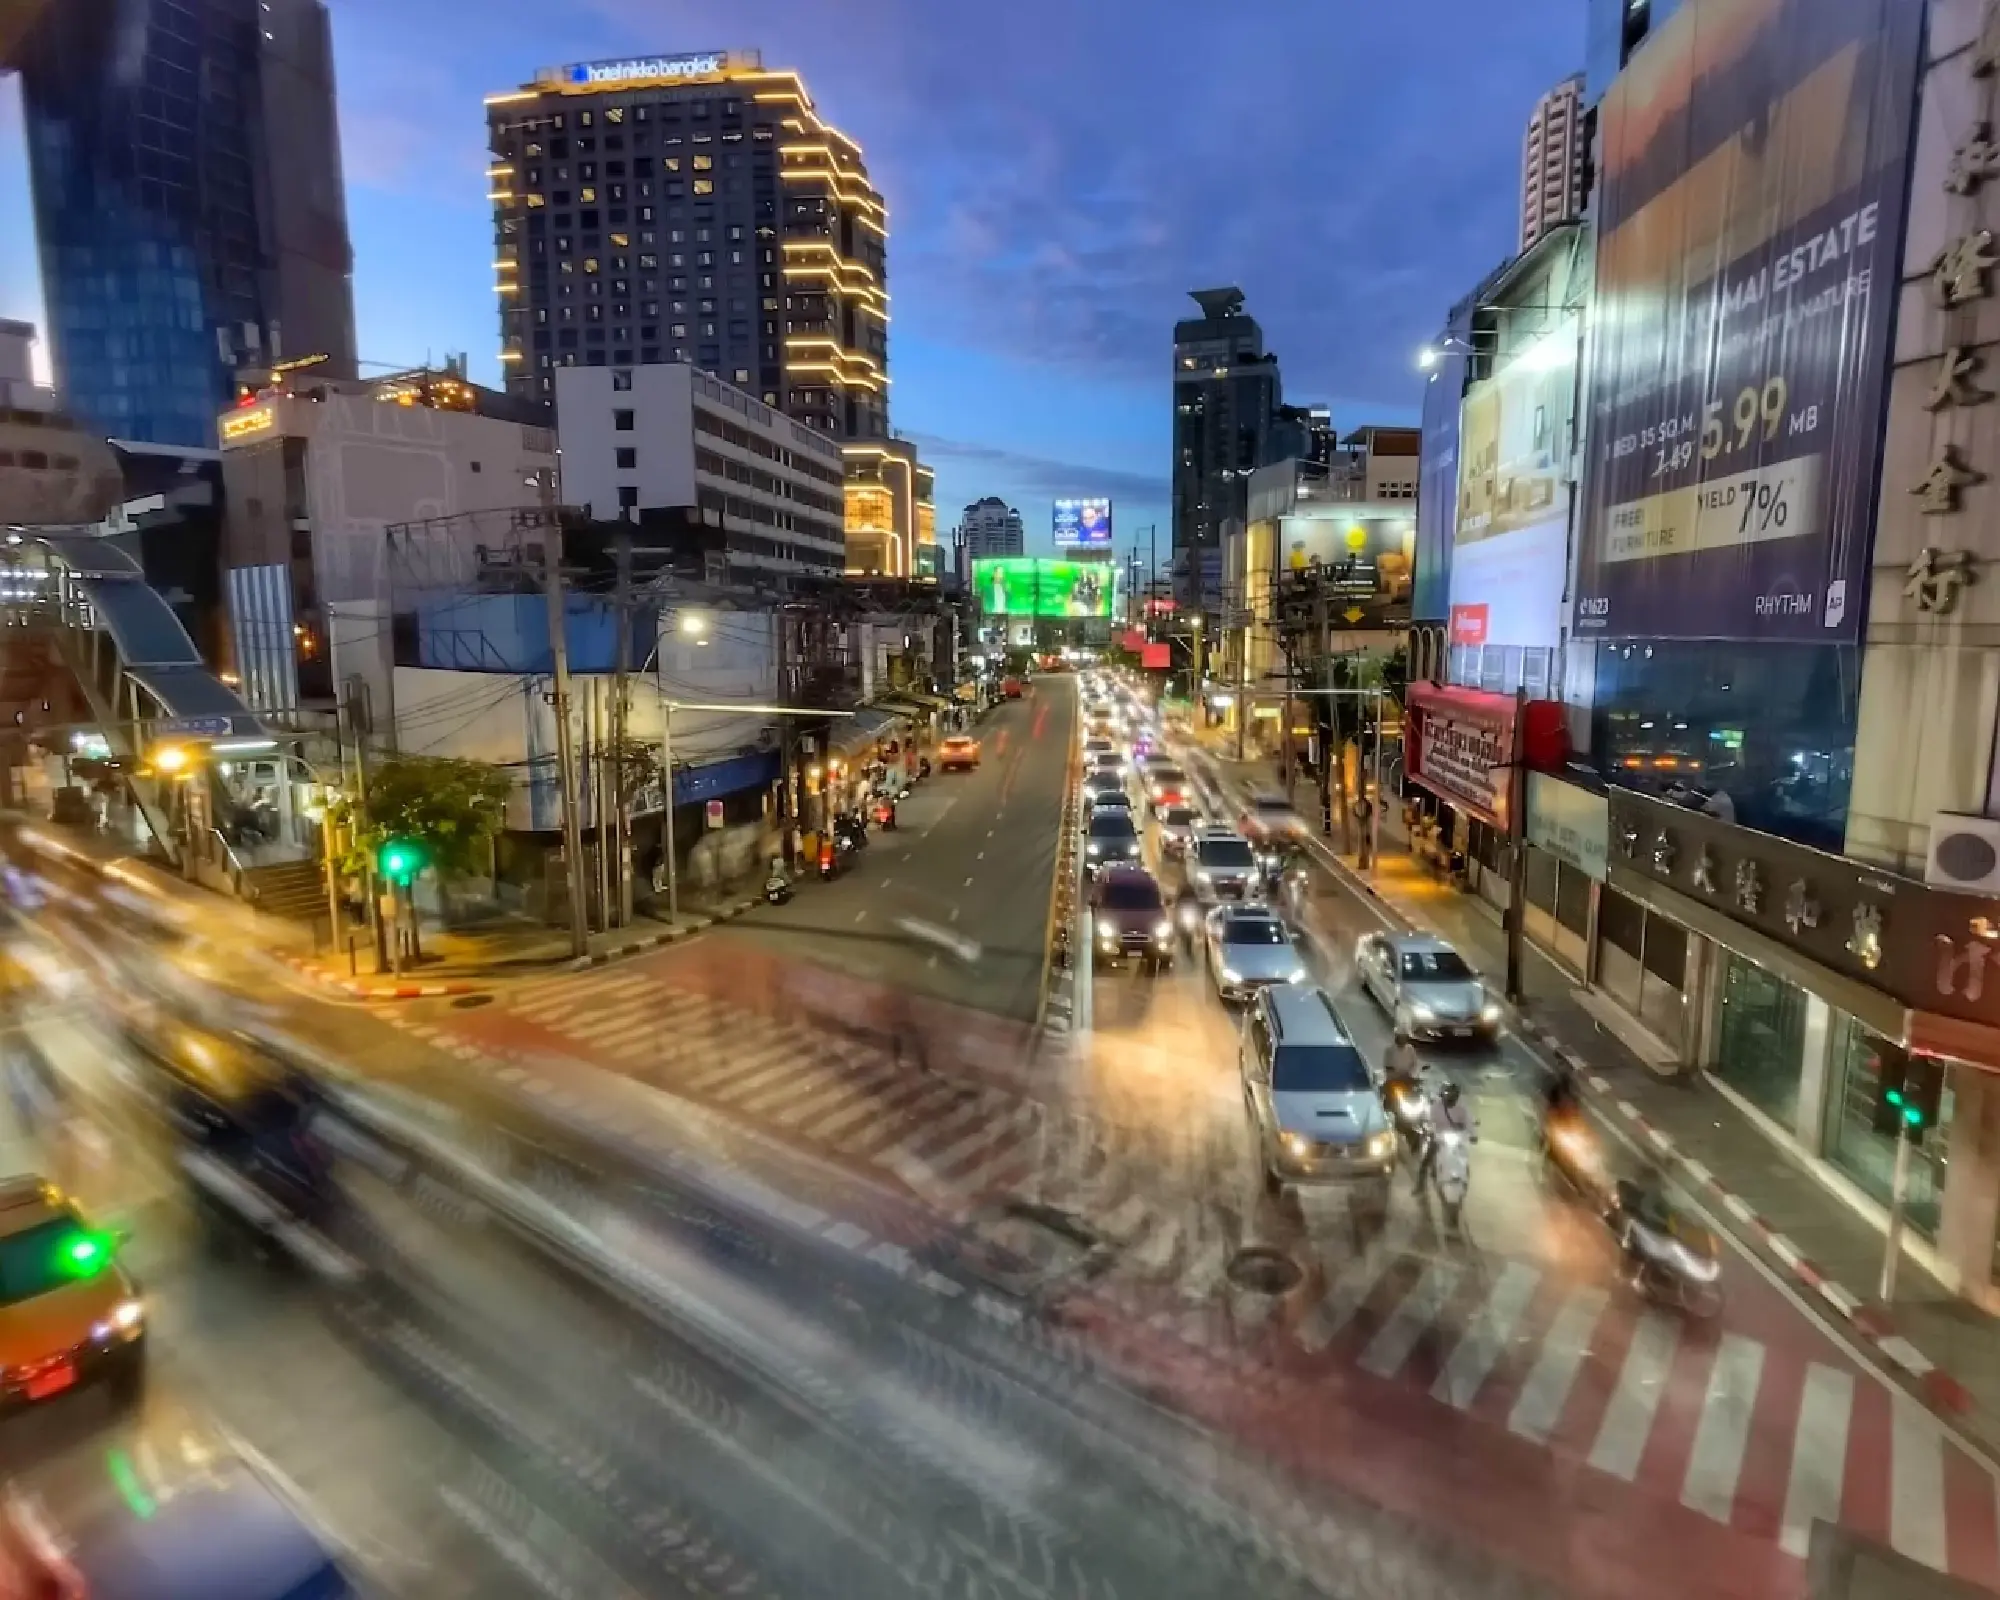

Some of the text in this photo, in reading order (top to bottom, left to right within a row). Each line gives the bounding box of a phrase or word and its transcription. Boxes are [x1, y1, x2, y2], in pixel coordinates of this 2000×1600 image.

[588, 55, 720, 83] hotel nikko bangkok
[1772, 200, 1879, 293] ESTATE
[1700, 376, 1788, 460] 5.99
[1698, 480, 1788, 534] YIELD 7%
[1612, 527, 1676, 553] FURNITURE
[1755, 594, 1812, 615] RHYTHM
